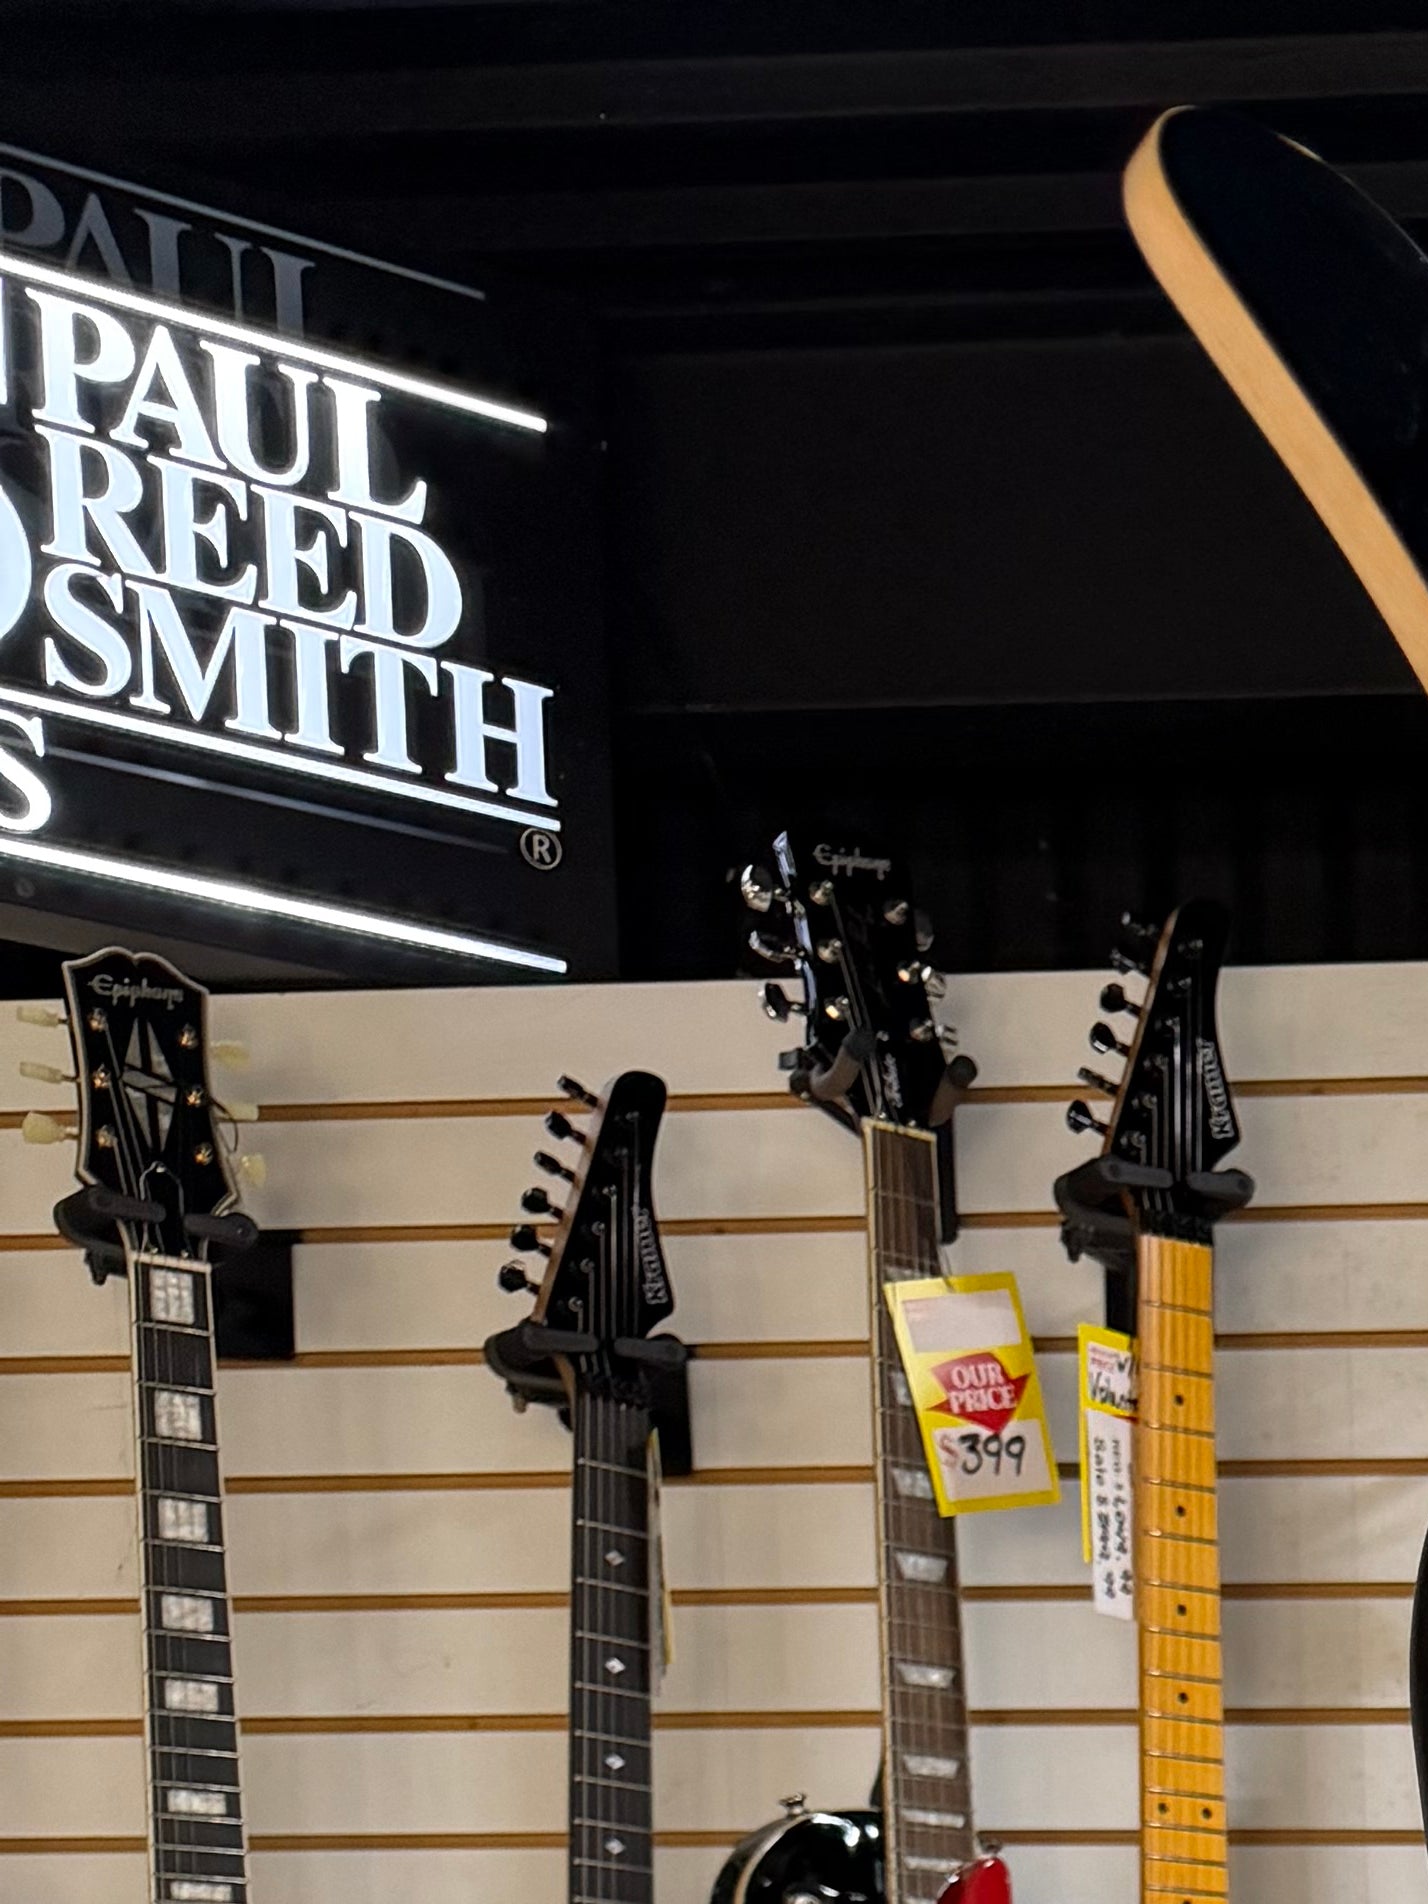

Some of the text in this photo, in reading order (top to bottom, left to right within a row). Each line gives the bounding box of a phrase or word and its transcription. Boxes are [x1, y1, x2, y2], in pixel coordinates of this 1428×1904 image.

[26, 288, 428, 525] PAUL
[35, 425, 463, 651] REED
[44, 563, 560, 807] SMITH
[1197, 1036, 1235, 1140] Kramer
[949, 1384, 1017, 1416] PRICE
[951, 1362, 1004, 1390] OUR
